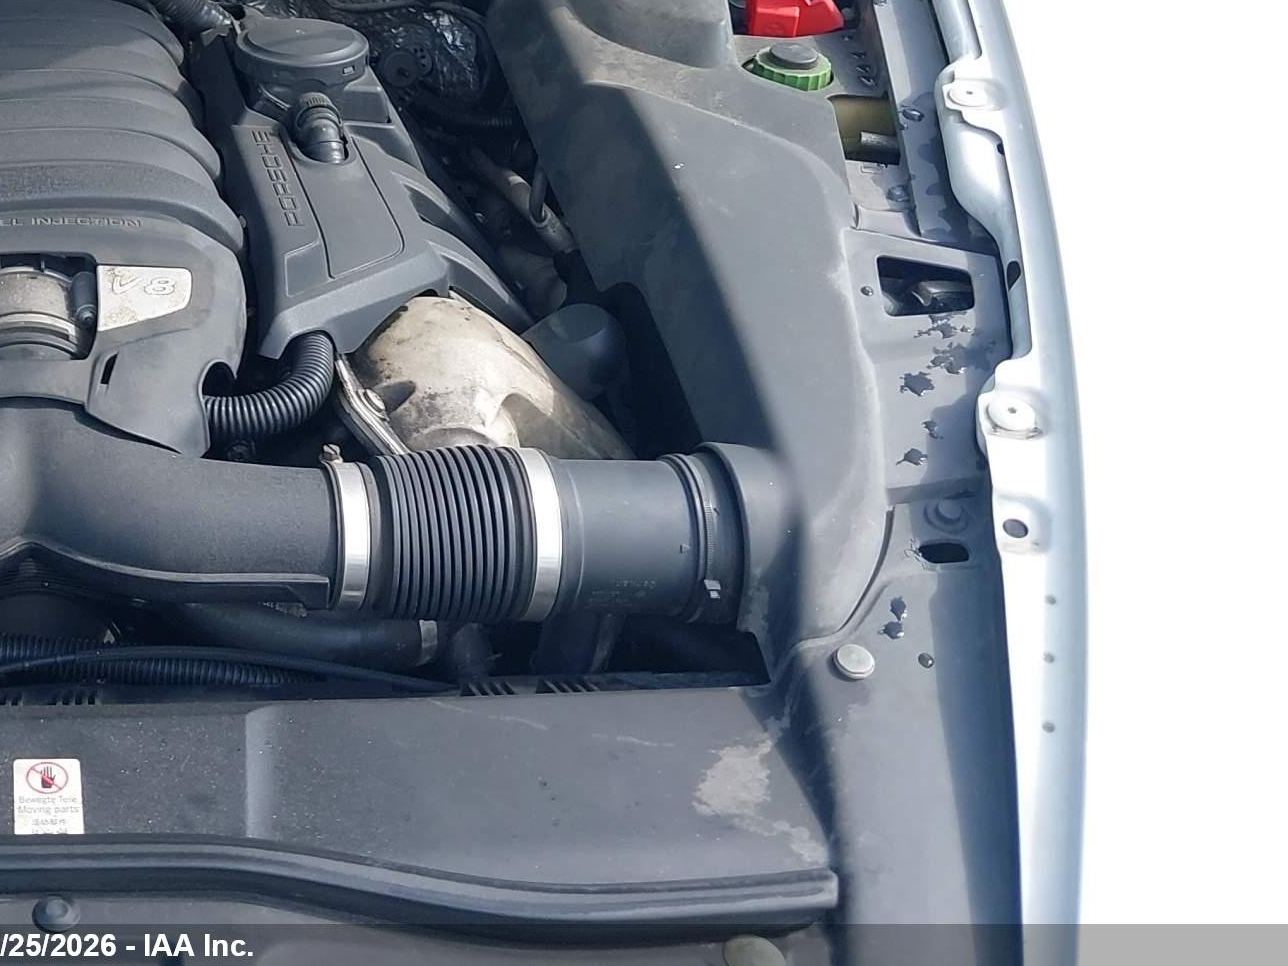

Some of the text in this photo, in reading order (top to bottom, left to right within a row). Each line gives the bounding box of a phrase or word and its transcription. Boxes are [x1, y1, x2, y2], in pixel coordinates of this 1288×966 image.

[251, 129, 305, 227] PORSCHE
[31, 216, 142, 228] INJECTION
[17, 806, 80, 815] Moving parts
